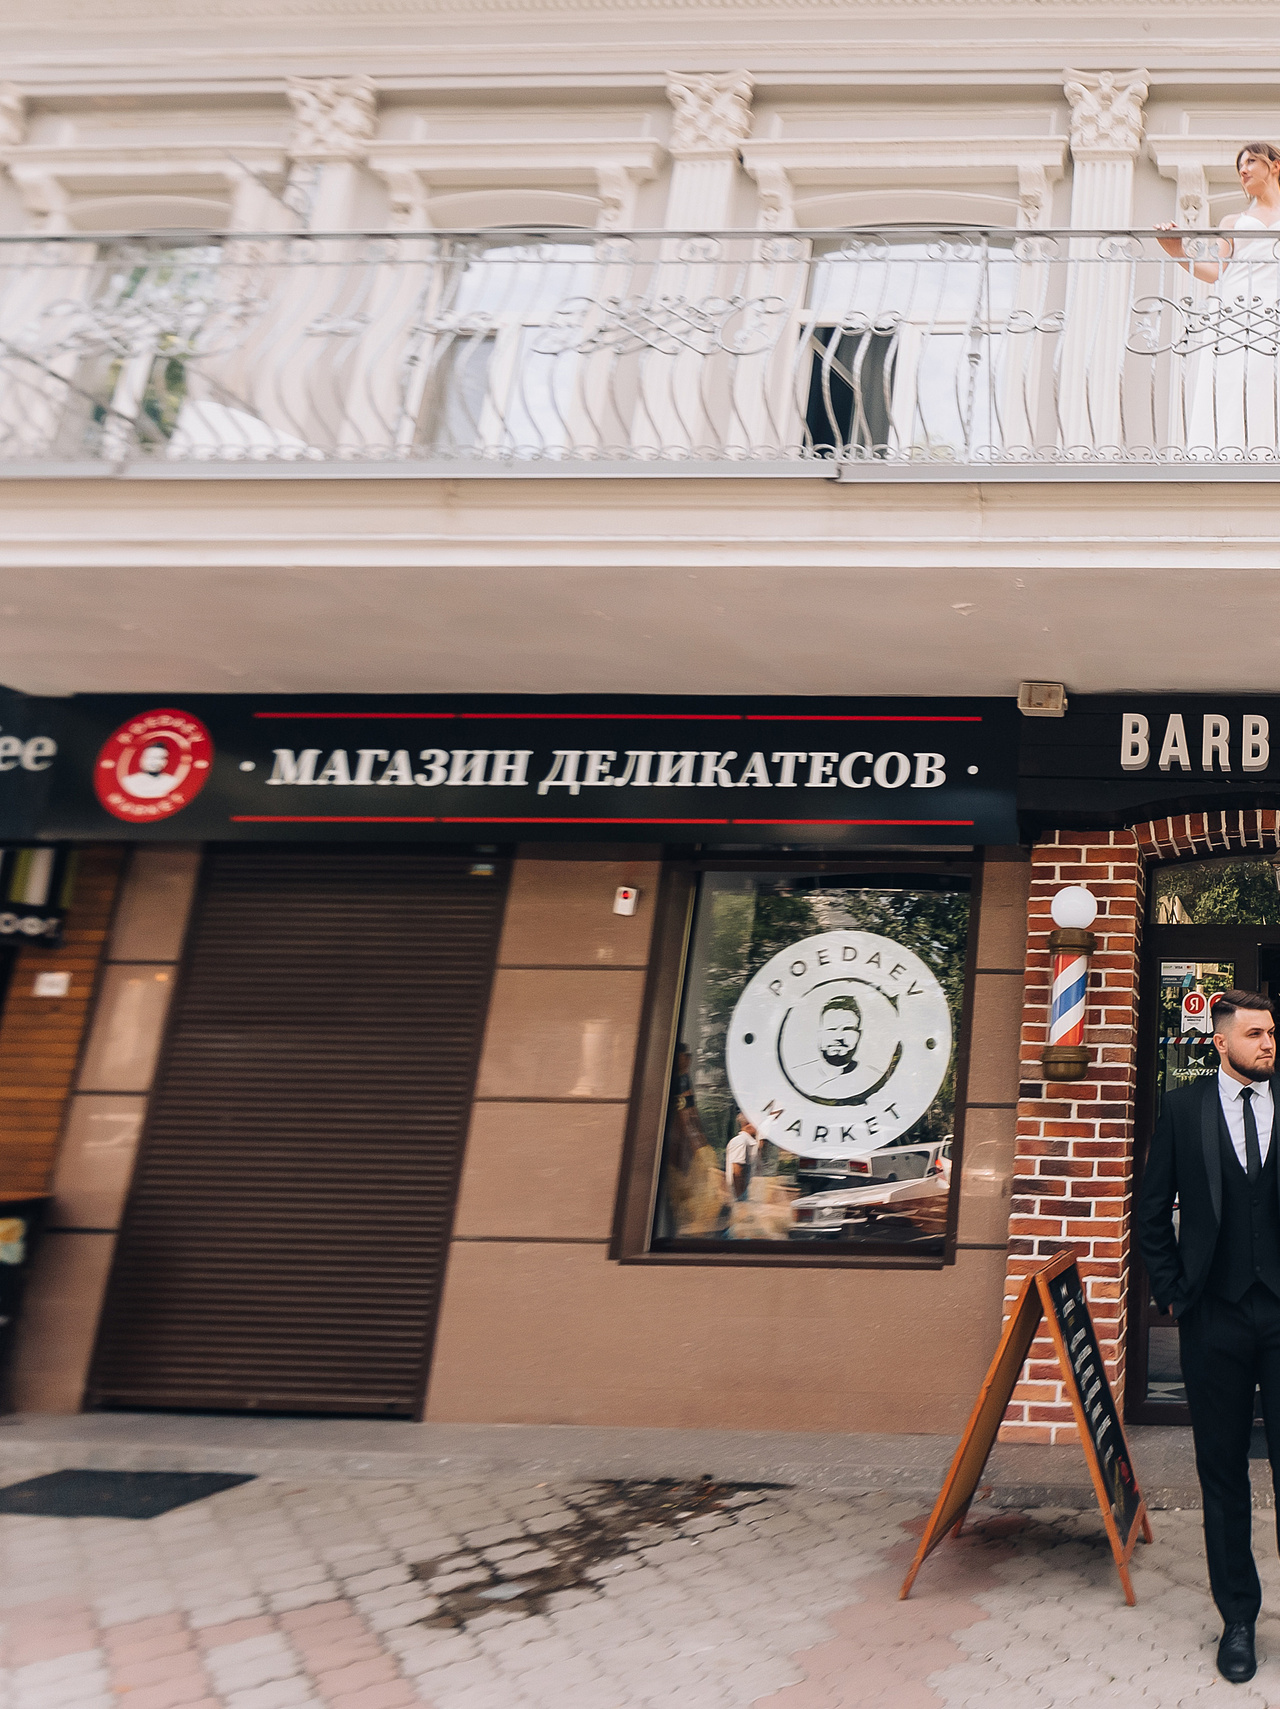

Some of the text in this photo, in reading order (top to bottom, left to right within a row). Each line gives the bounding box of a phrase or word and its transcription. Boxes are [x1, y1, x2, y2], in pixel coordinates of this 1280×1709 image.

[265, 748, 947, 796] МАГАЗИН ДЕЛИКАТЕСОВ
[768, 946, 924, 997] POEDAEV
[761, 1099, 901, 1143] MARKET
